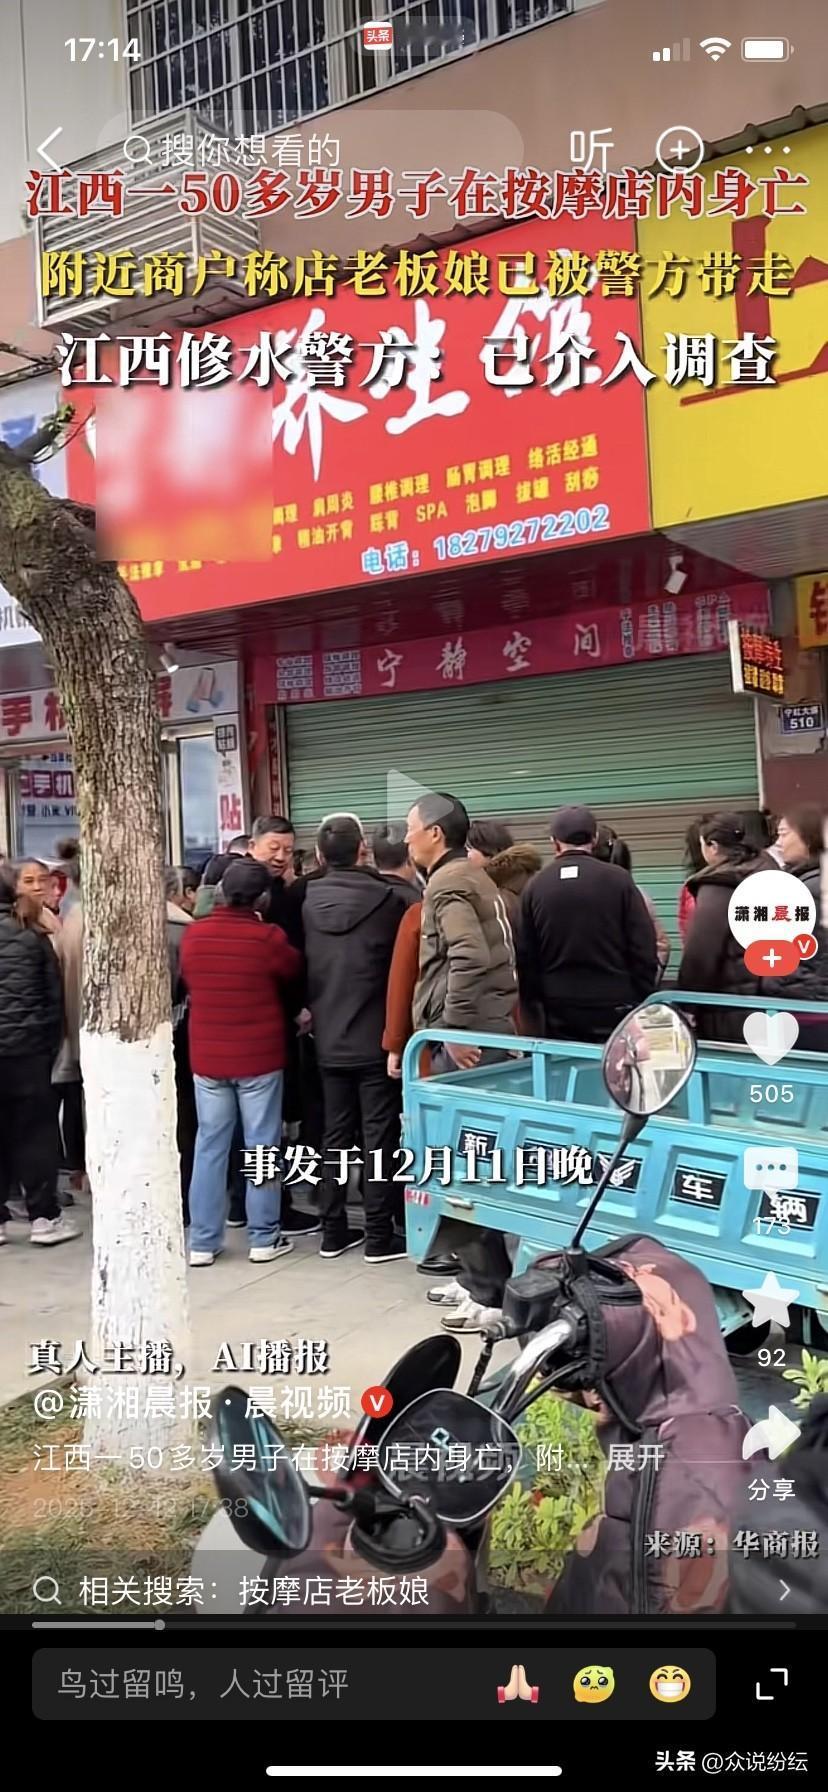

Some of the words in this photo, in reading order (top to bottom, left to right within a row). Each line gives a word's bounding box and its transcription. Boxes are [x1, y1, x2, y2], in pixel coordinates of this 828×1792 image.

[416, 501, 448, 522] SPA
[433, 503, 611, 560] 18279272202
[790, 717, 814, 729] 510
